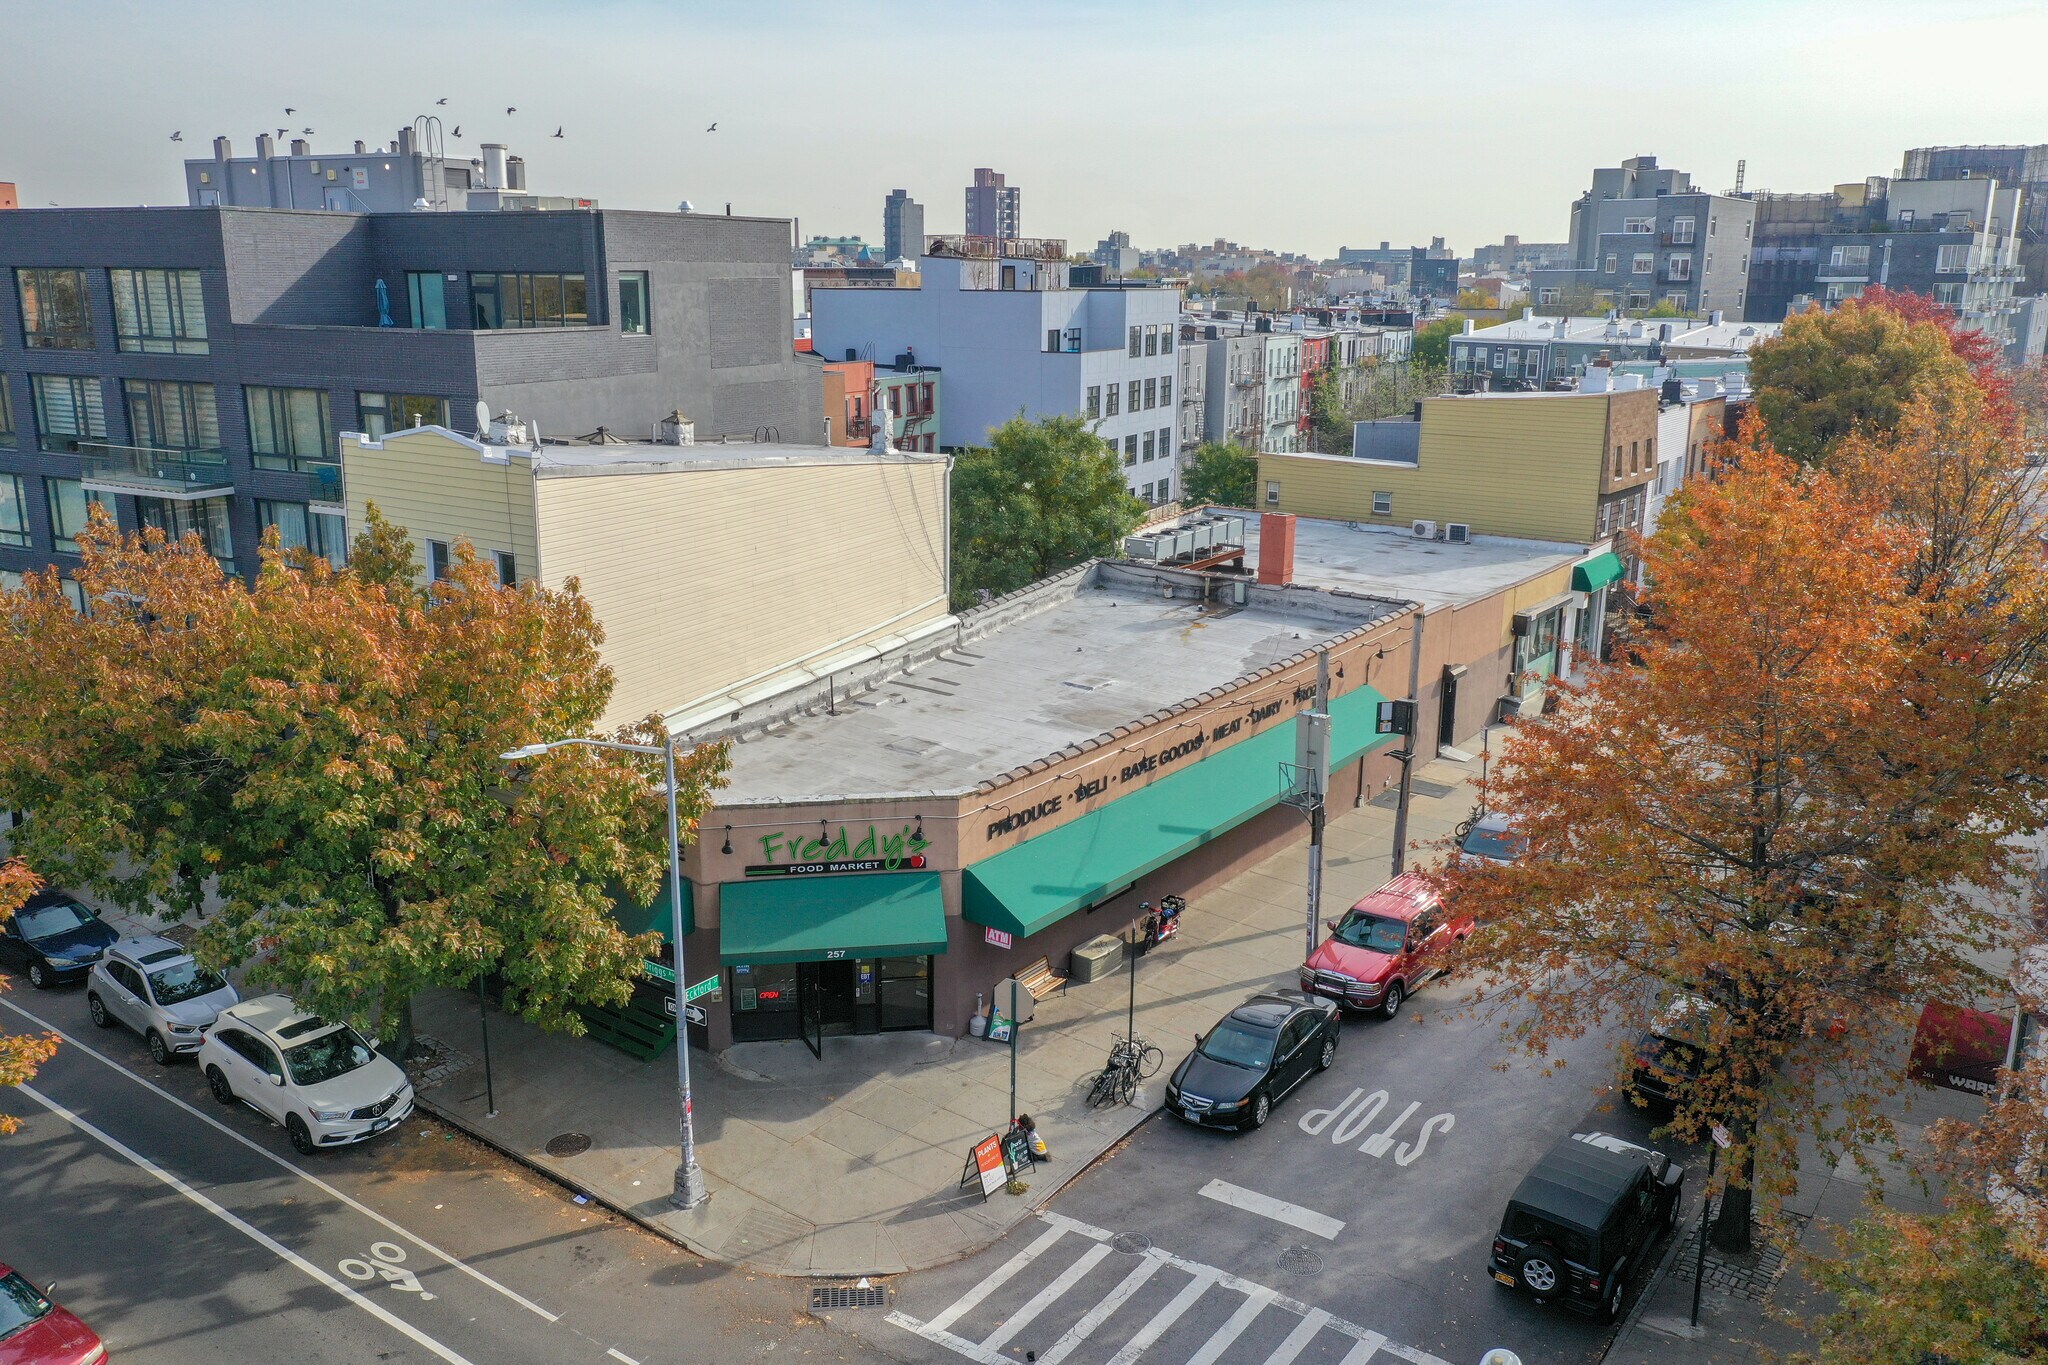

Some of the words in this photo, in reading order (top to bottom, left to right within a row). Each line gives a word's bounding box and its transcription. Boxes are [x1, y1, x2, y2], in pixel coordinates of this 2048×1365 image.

[986, 795, 1062, 842] PRODUCE
[1074, 775, 1108, 803] DELI
[1120, 754, 1158, 783] BAKE
[1159, 734, 1205, 766] GOODS
[1212, 716, 1243, 743] MEAT
[1251, 699, 1283, 725] DAIRY
[759, 824, 932, 871] Freddy's
[790, 864, 824, 874] FOOD
[829, 861, 879, 872] MARKET
[987, 928, 1009, 944] ATM
[827, 950, 846, 958] 257
[644, 961, 666, 978] Driggs
[685, 980, 712, 1001] Eckford
[759, 991, 779, 1000] OPEN
[1922, 1070, 1935, 1079] 261
[1298, 1087, 1456, 1166] STOP
